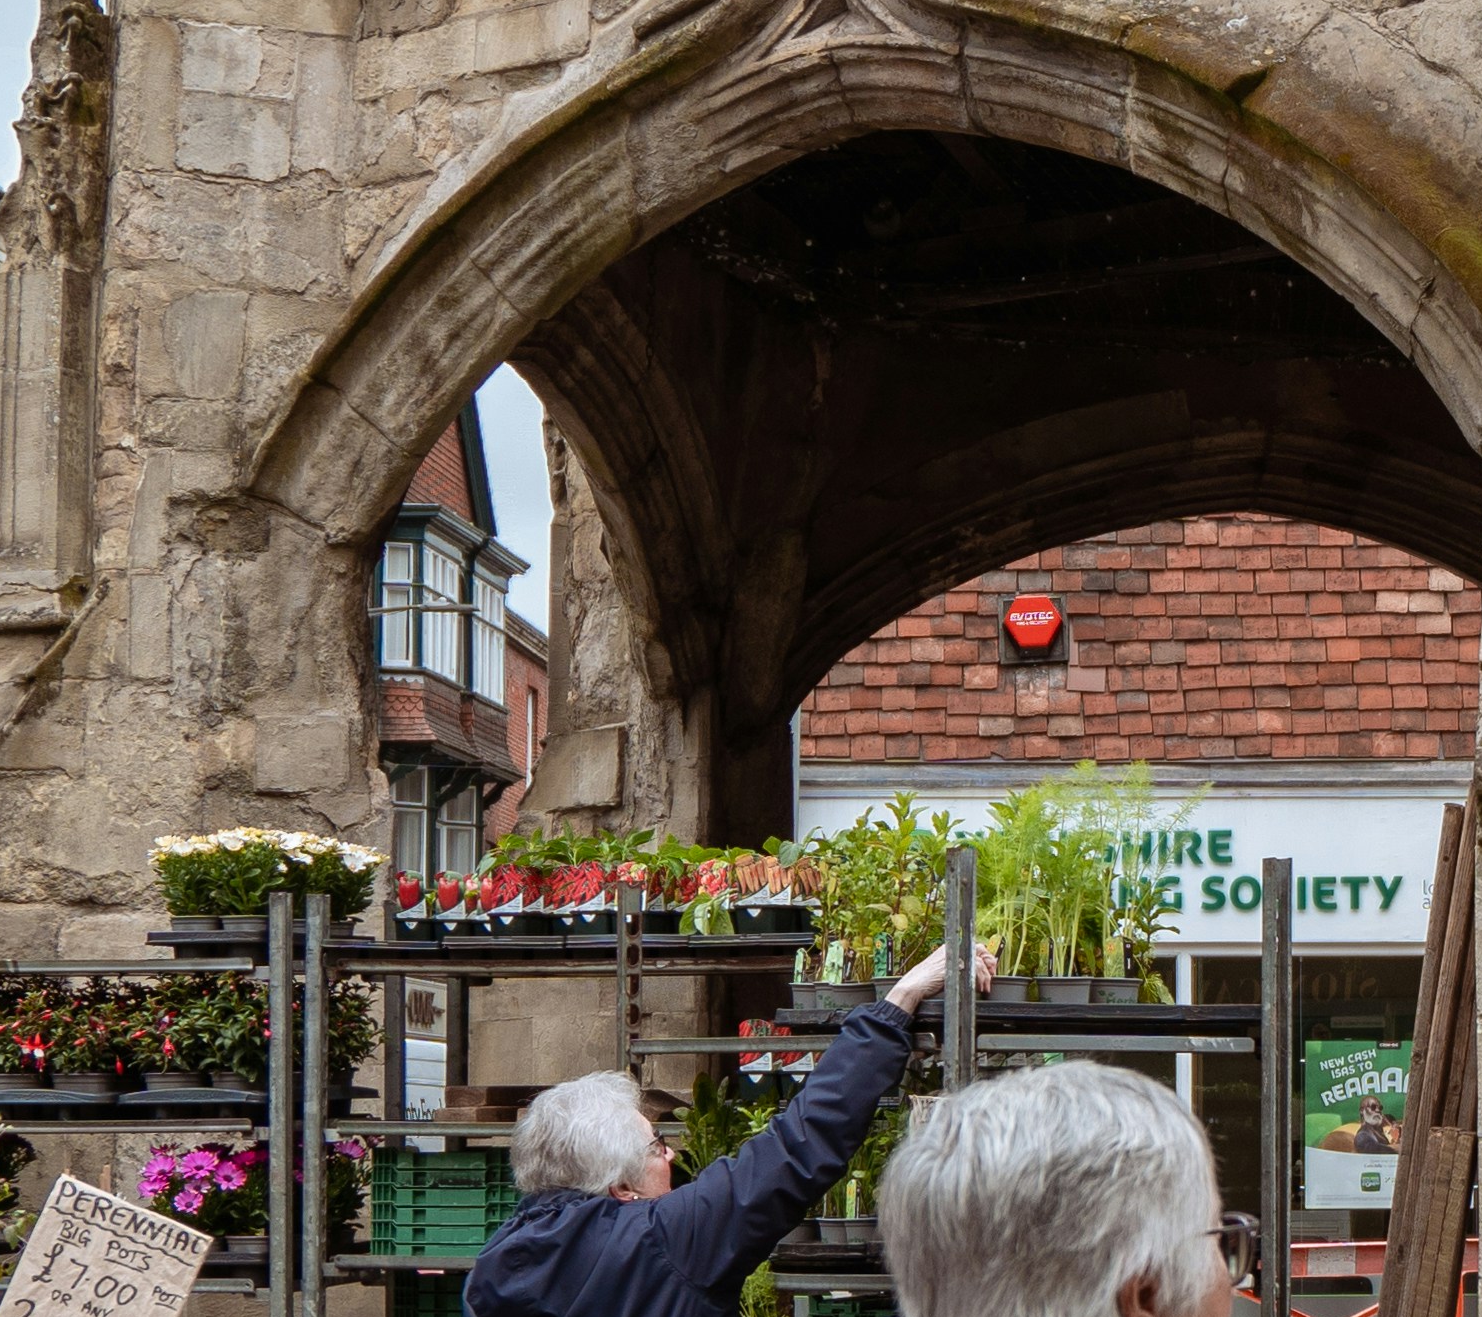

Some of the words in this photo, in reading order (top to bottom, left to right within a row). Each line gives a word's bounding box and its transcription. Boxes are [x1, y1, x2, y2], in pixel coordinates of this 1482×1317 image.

[1200, 875, 1404, 912] SOIETY
[1319, 1056, 1345, 1072] NEW
[1346, 1048, 1377, 1066] CASH
[1330, 1064, 1356, 1080] ISAS
[1358, 1060, 1374, 1073] TO
[59, 1219, 91, 1246] BIG
[105, 1239, 154, 1272] POTS
[32, 1242, 138, 1306] £7.00
[152, 1284, 185, 1305] POT
[51, 1288, 72, 1307] OR
